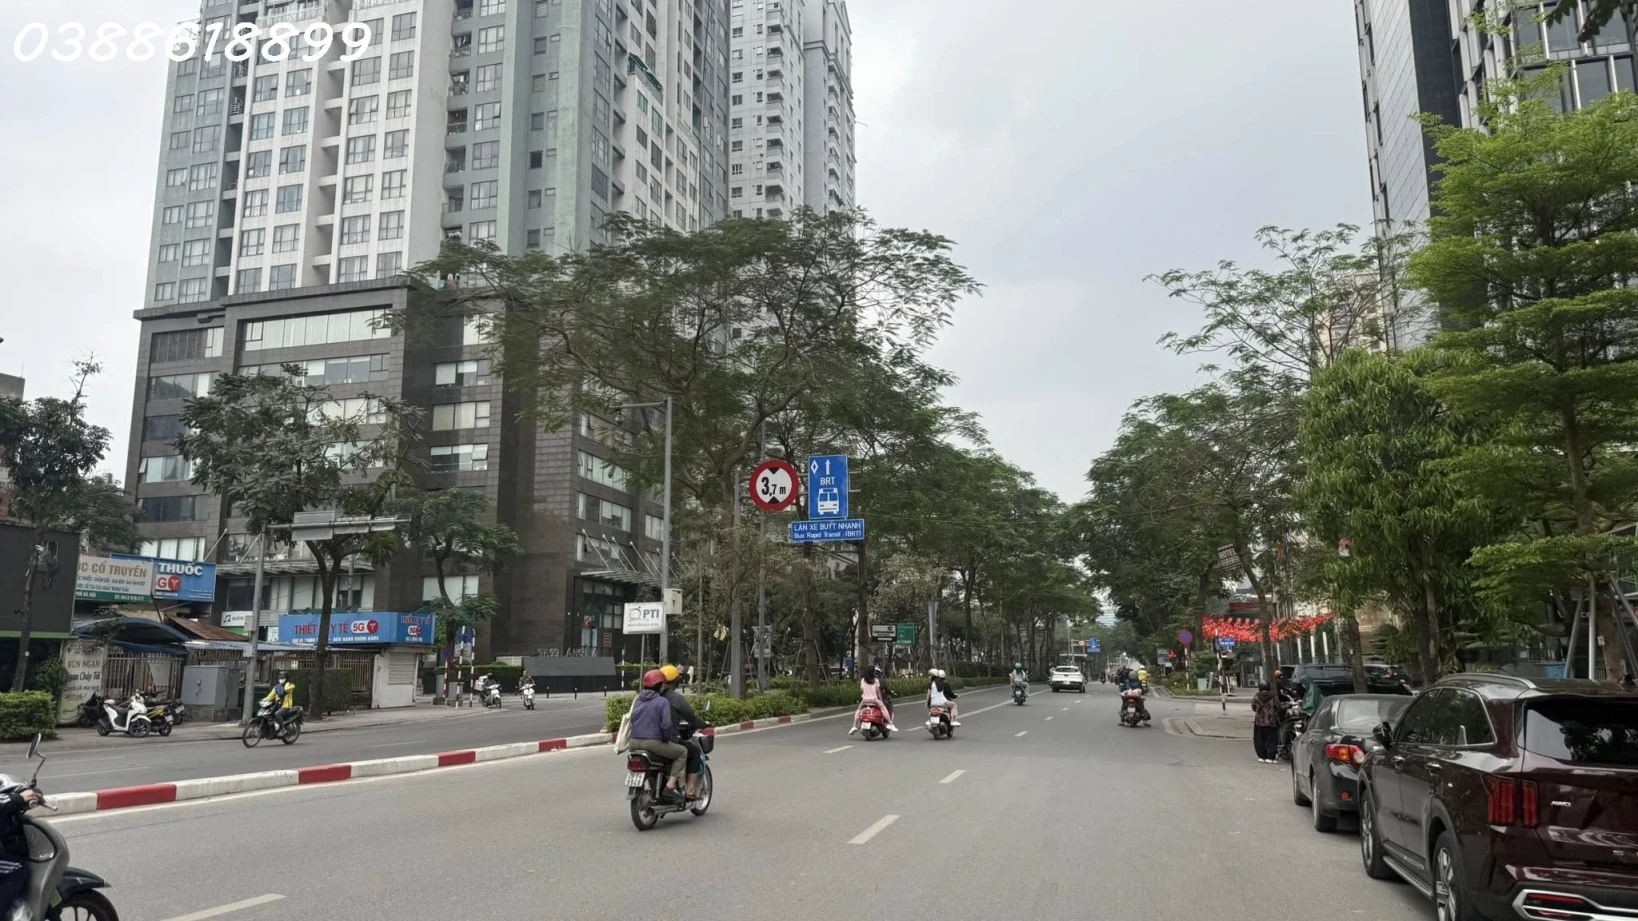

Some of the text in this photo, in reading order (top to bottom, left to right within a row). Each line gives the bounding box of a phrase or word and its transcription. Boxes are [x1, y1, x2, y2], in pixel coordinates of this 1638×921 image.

[820, 477, 835, 485] BRT
[761, 477, 786, 496] 3,7 m
[809, 523, 818, 531] XE
[820, 521, 837, 530] BUÝT
[838, 521, 861, 530] NHANH
[806, 531, 822, 539] Rapid
[158, 562, 203, 576] THUỐC
[643, 609, 660, 619] PTI
[294, 619, 365, 634] THIẾT Y TẾ 5G
[82, 660, 100, 669] NGAN
